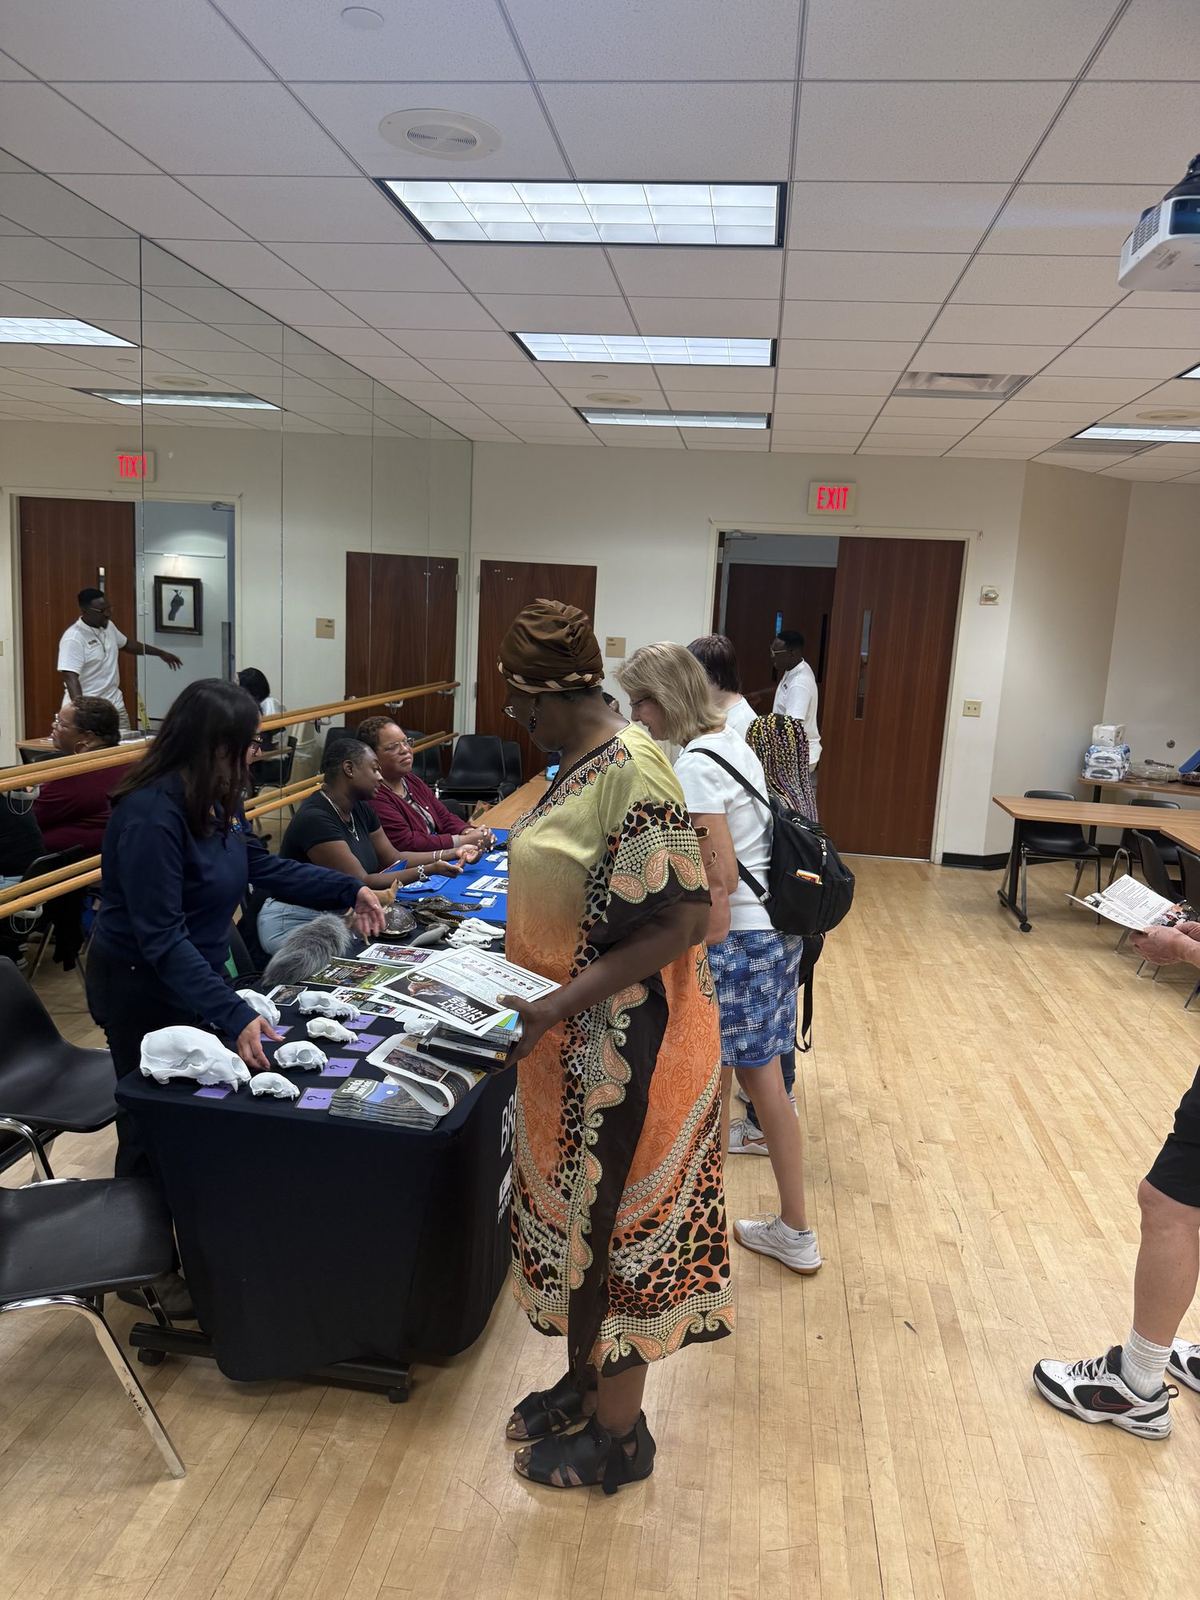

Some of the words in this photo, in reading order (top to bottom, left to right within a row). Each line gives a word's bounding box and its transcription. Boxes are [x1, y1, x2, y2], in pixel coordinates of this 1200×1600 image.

[816, 486, 849, 510] EXIT
[437, 1000, 480, 1023] NIGHT
[448, 995, 488, 1018] HIKES
